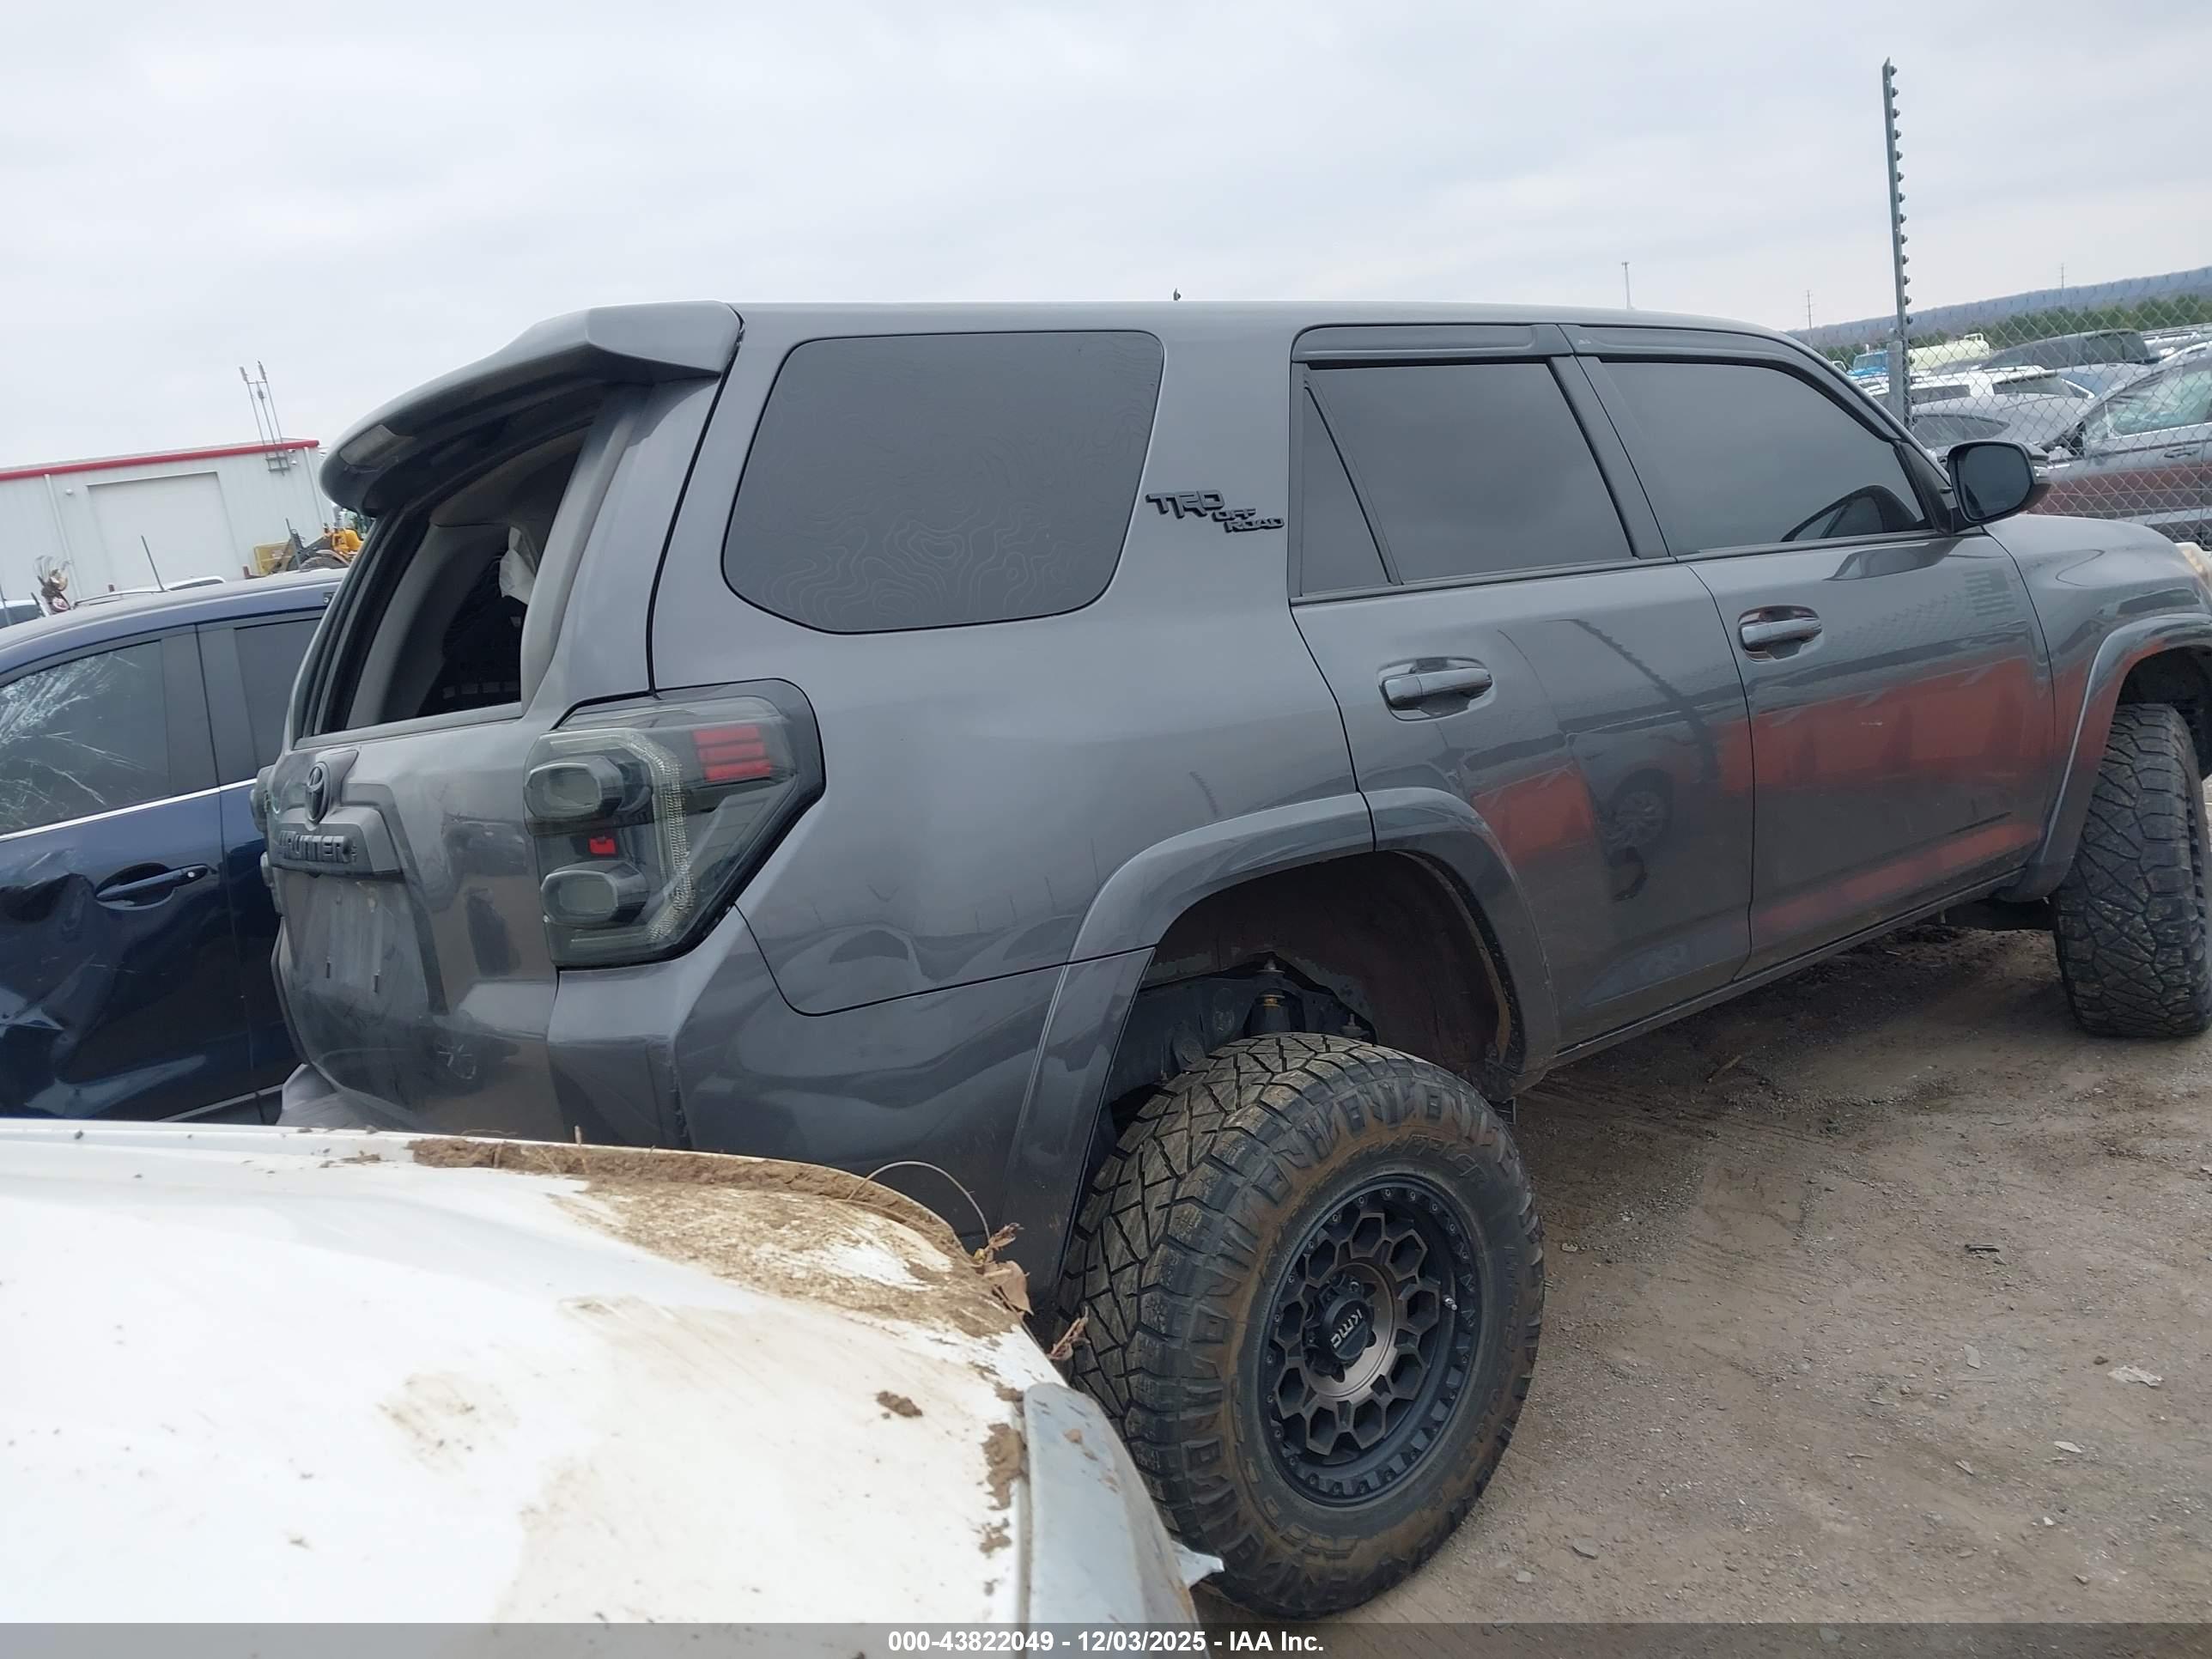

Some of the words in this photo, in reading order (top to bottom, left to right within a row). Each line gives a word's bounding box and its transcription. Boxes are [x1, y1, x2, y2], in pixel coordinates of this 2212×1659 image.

[1146, 489, 1224, 519] TRD
[1224, 517, 1285, 533] ROAD
[1330, 1309, 1364, 1349] KMC
